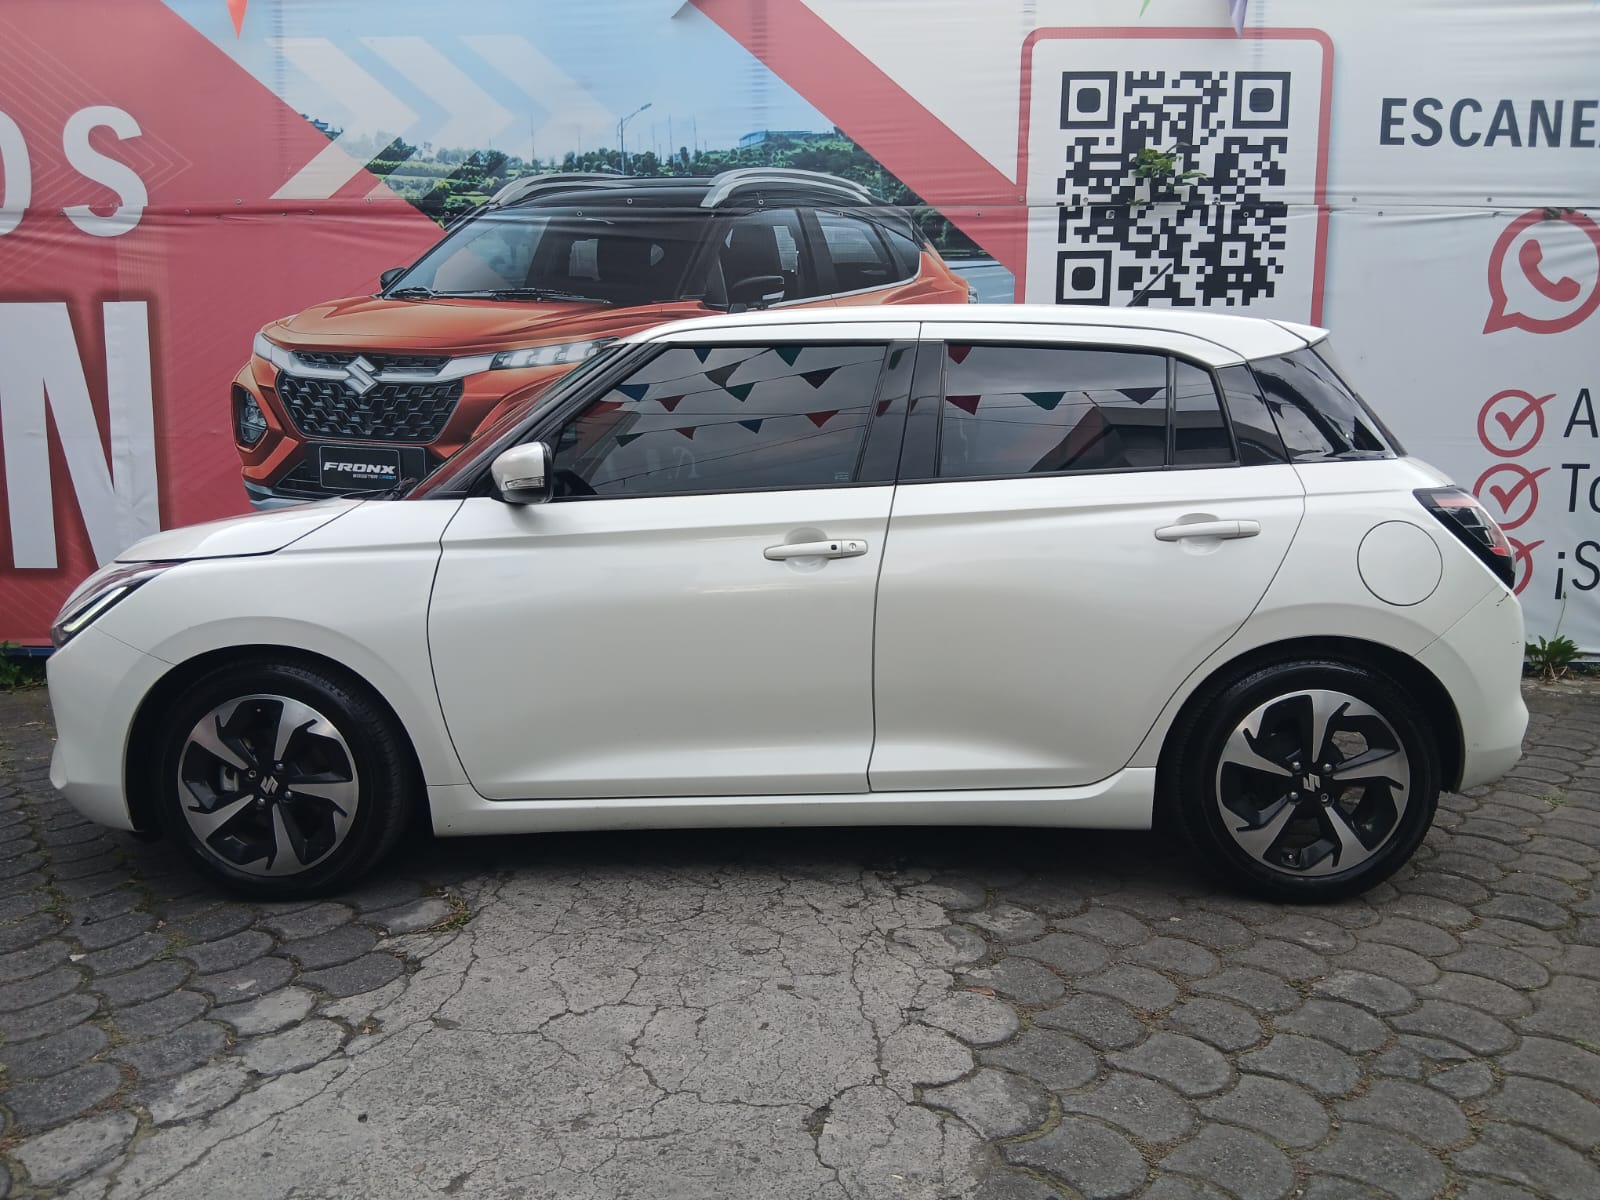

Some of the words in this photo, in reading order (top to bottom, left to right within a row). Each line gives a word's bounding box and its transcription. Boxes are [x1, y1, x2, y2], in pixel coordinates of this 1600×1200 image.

[1381, 97, 1600, 149] ESCANE
[1563, 388, 1599, 438] A
[323, 461, 396, 475] FRONX
